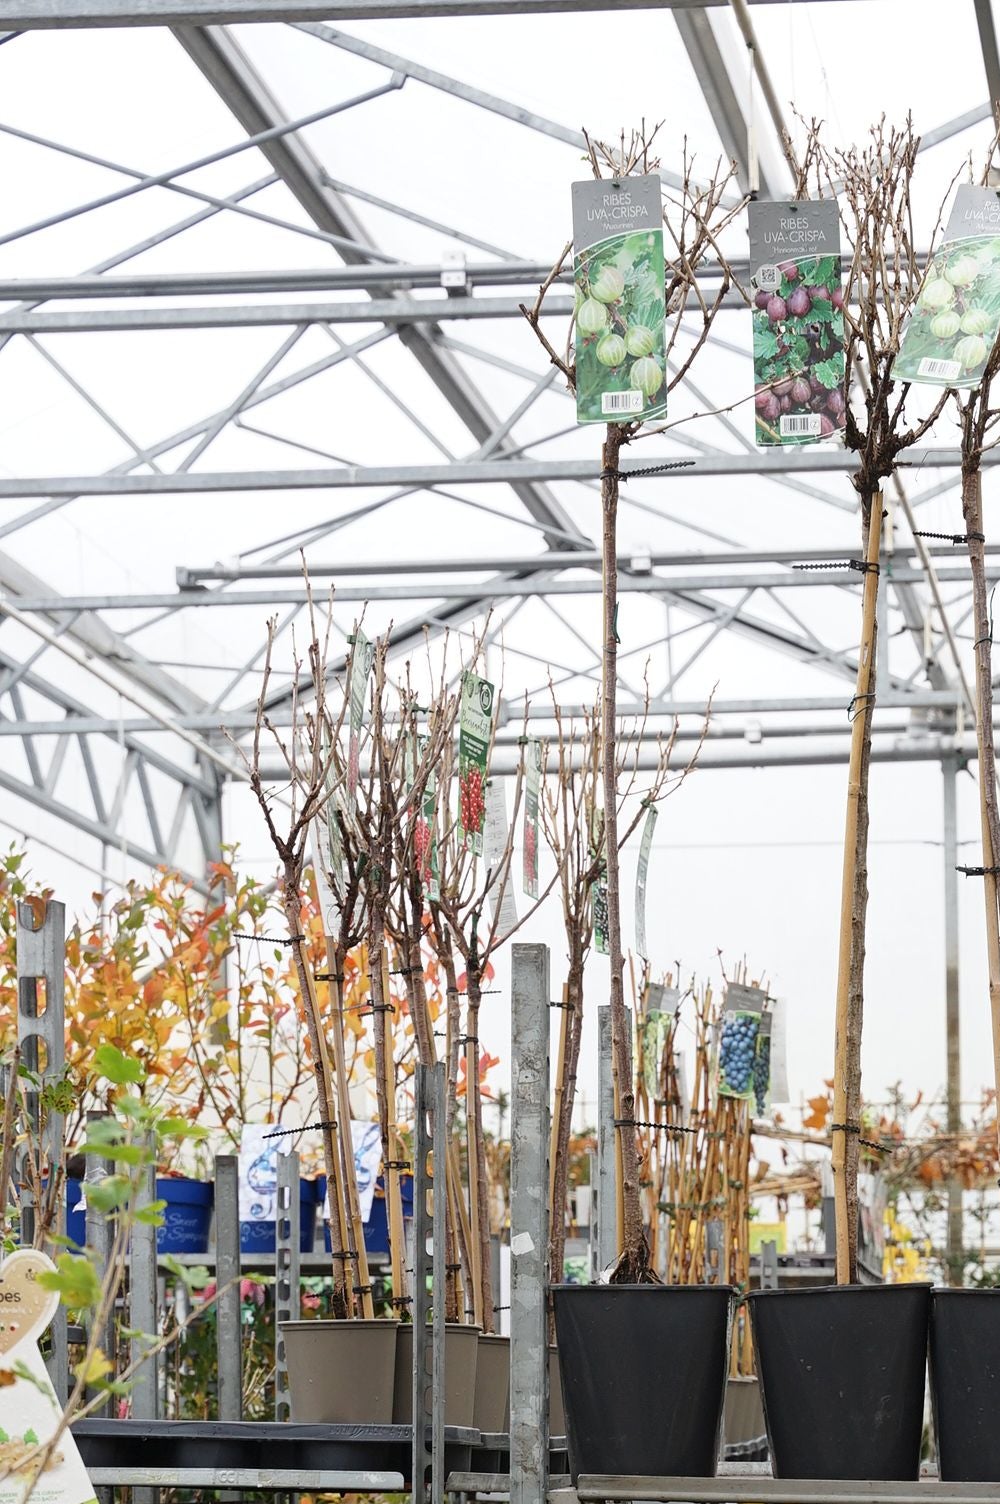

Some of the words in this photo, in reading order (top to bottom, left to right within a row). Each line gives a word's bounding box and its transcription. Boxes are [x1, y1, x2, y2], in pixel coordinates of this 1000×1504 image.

[603, 193, 631, 206] RIBES
[587, 205, 648, 221] UVA-CRISPA
[780, 217, 809, 230] RIBES
[763, 229, 827, 243] UVA-CRISPA
